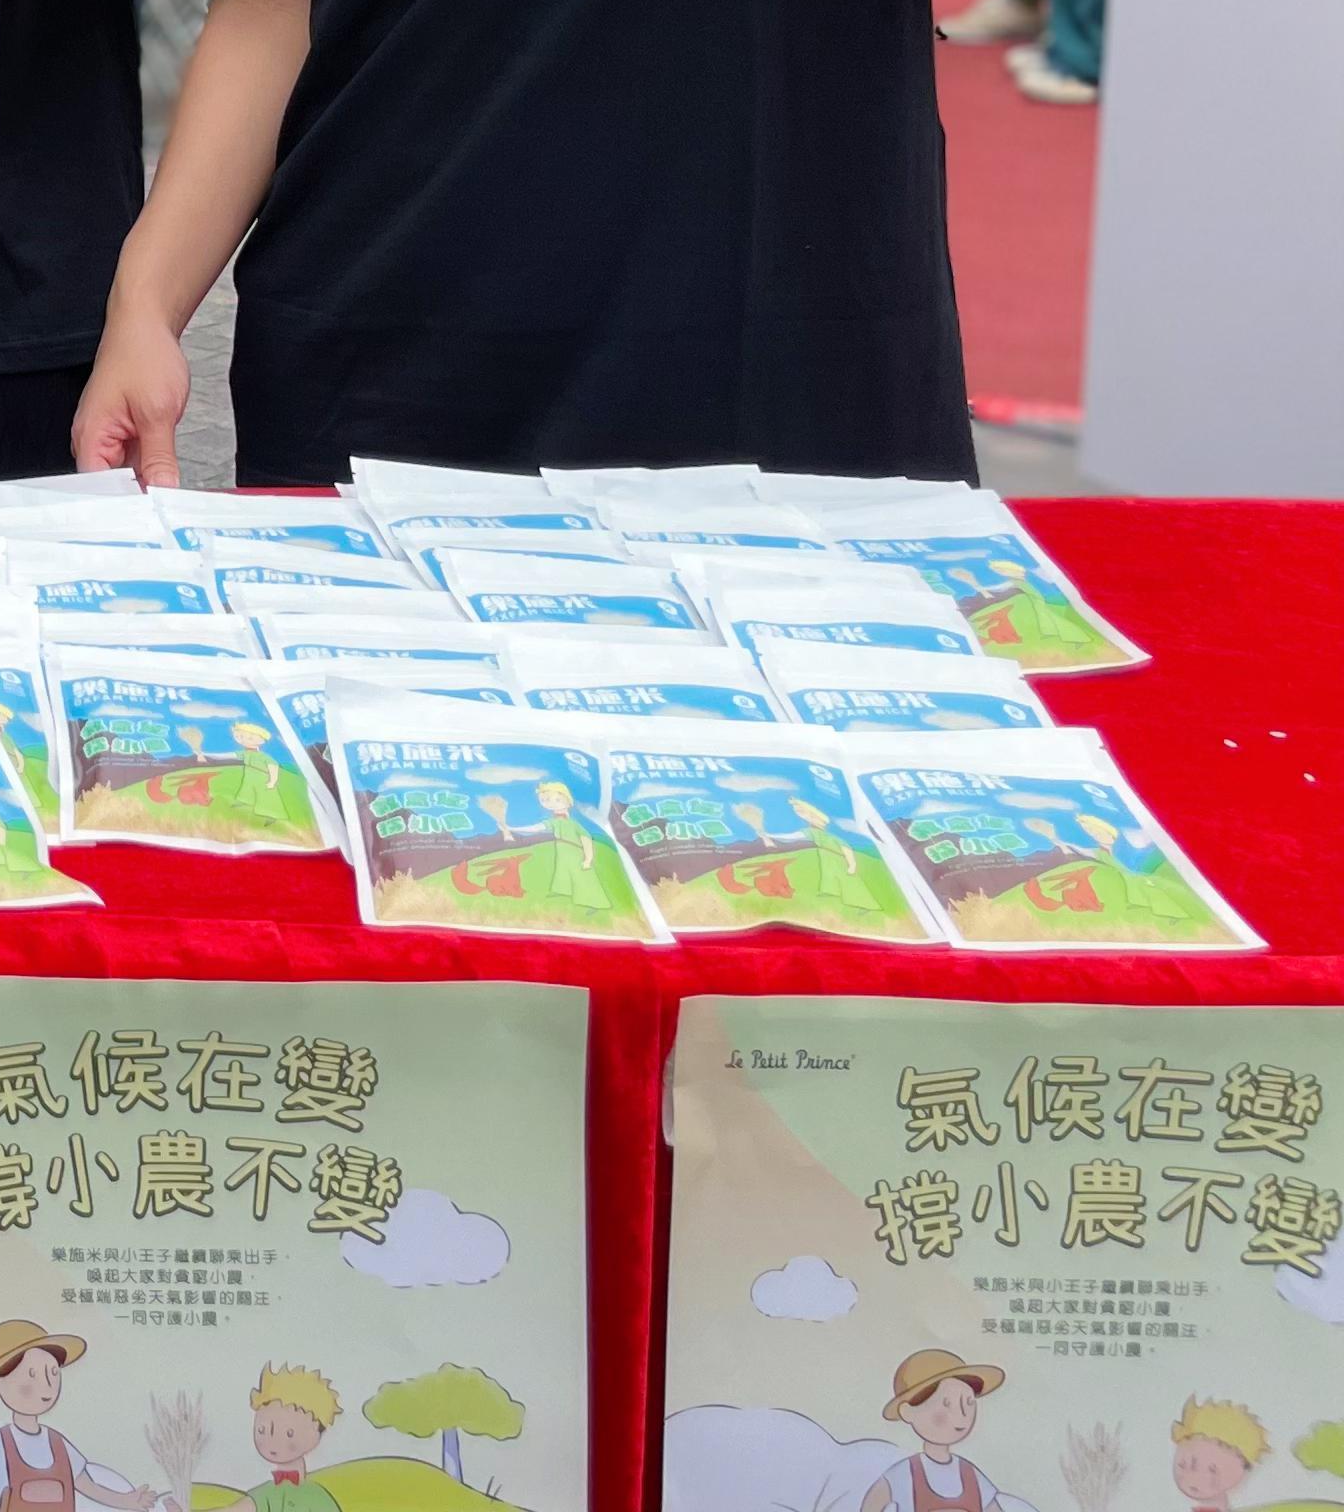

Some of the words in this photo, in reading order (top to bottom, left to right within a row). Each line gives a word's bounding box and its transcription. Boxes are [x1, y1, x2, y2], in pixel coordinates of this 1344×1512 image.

[359, 761, 416, 775] OXFAM
[422, 761, 461, 771] RICE
[724, 1049, 745, 1069] Le
[752, 1050, 788, 1070] Petit
[796, 1050, 856, 1071] Prince
[897, 1056, 1324, 1163] 氣候在變
[865, 1157, 1344, 1279] 撐小農不變
